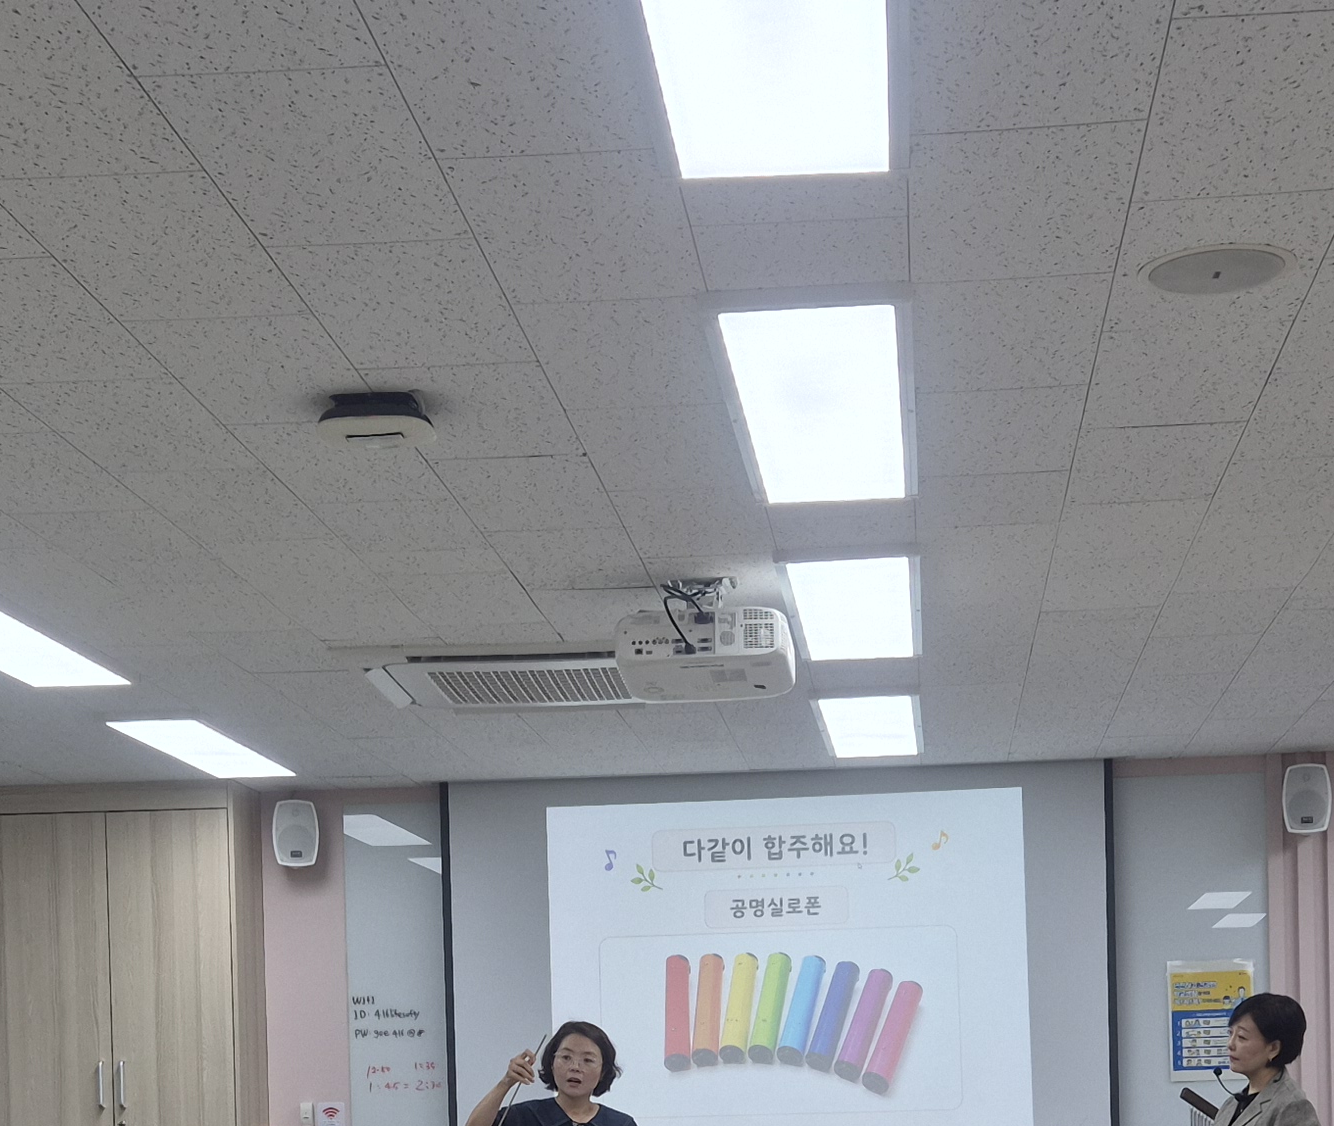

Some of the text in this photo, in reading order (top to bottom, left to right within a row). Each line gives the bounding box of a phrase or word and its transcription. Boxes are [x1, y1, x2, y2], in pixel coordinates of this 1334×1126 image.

[681, 832, 869, 863] 다같이 합주해요!
[729, 896, 822, 919] 공명실로폰
